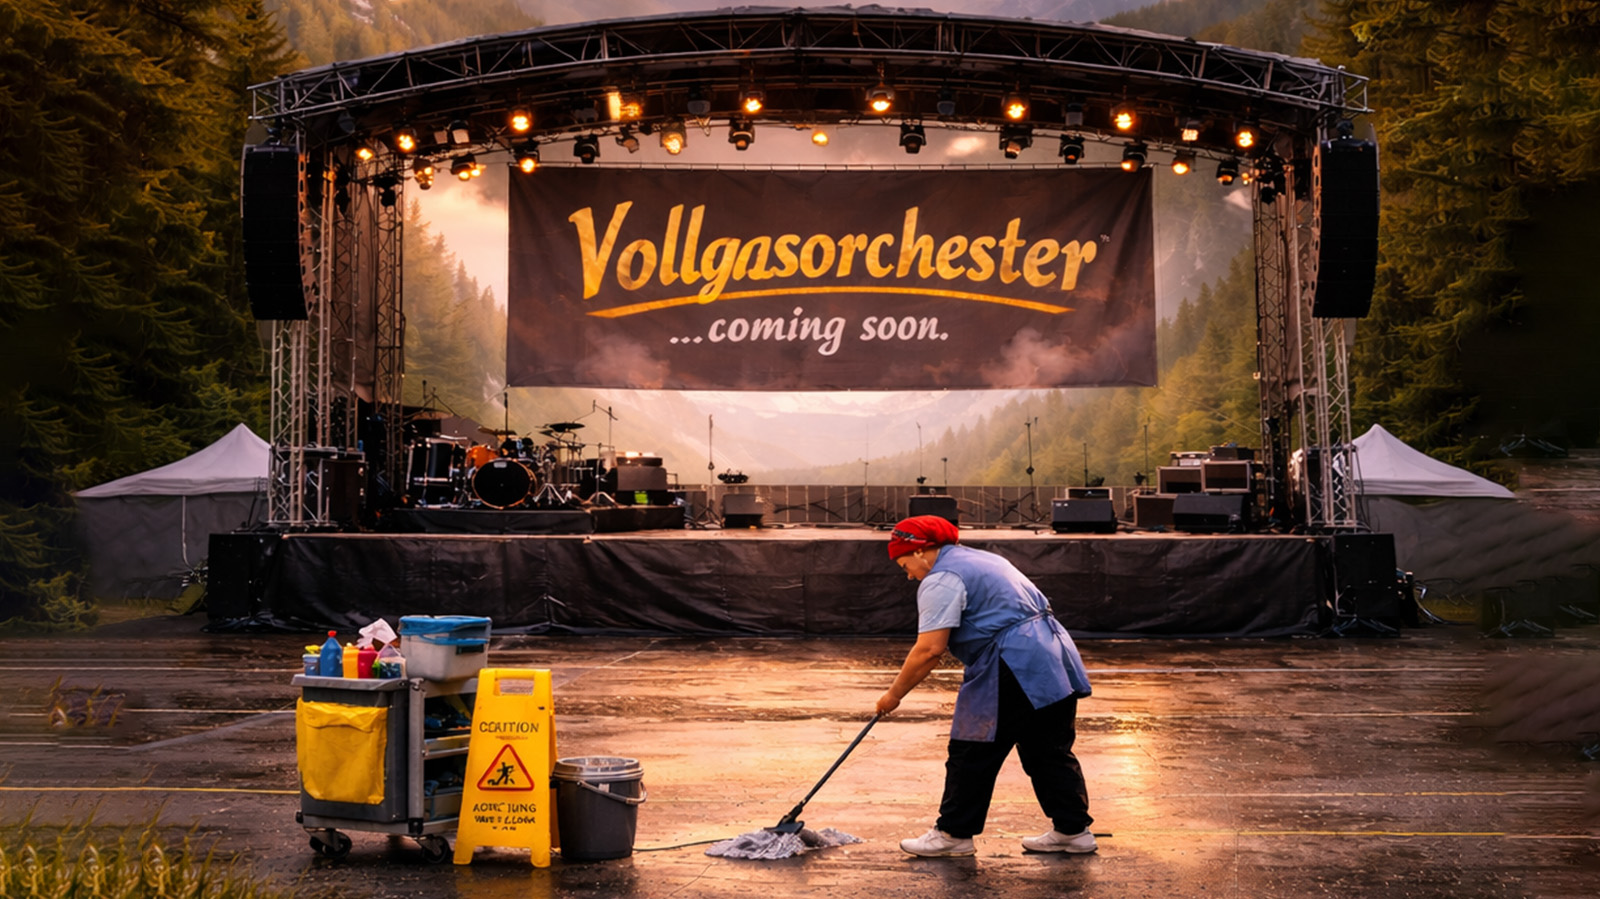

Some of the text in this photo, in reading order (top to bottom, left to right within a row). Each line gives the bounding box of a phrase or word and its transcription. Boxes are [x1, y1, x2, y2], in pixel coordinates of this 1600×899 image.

[567, 200, 1098, 304] Vollgasorchester
[669, 307, 949, 356] ...coming soon.
